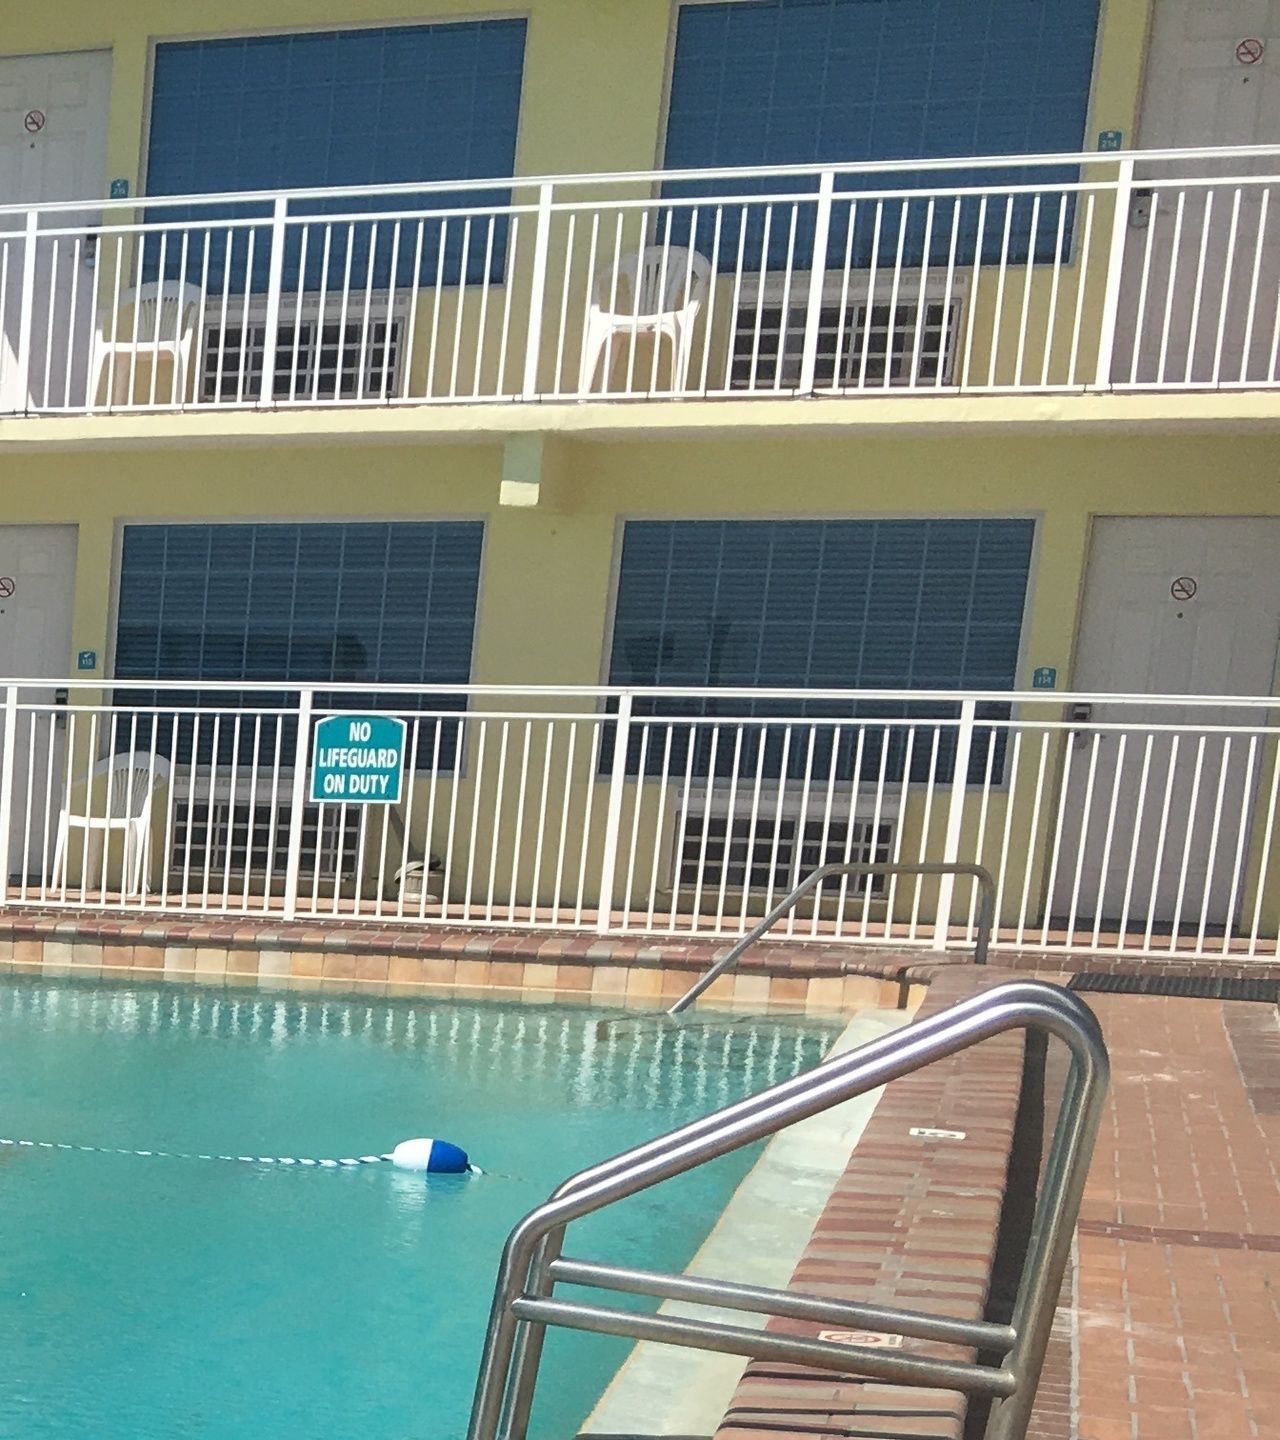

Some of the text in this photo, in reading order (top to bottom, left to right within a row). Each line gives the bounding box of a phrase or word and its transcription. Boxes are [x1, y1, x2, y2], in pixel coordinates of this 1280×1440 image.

[349, 722, 371, 741] NO
[319, 748, 397, 768] LIFEGUARD
[324, 774, 389, 794] ON DUTY
